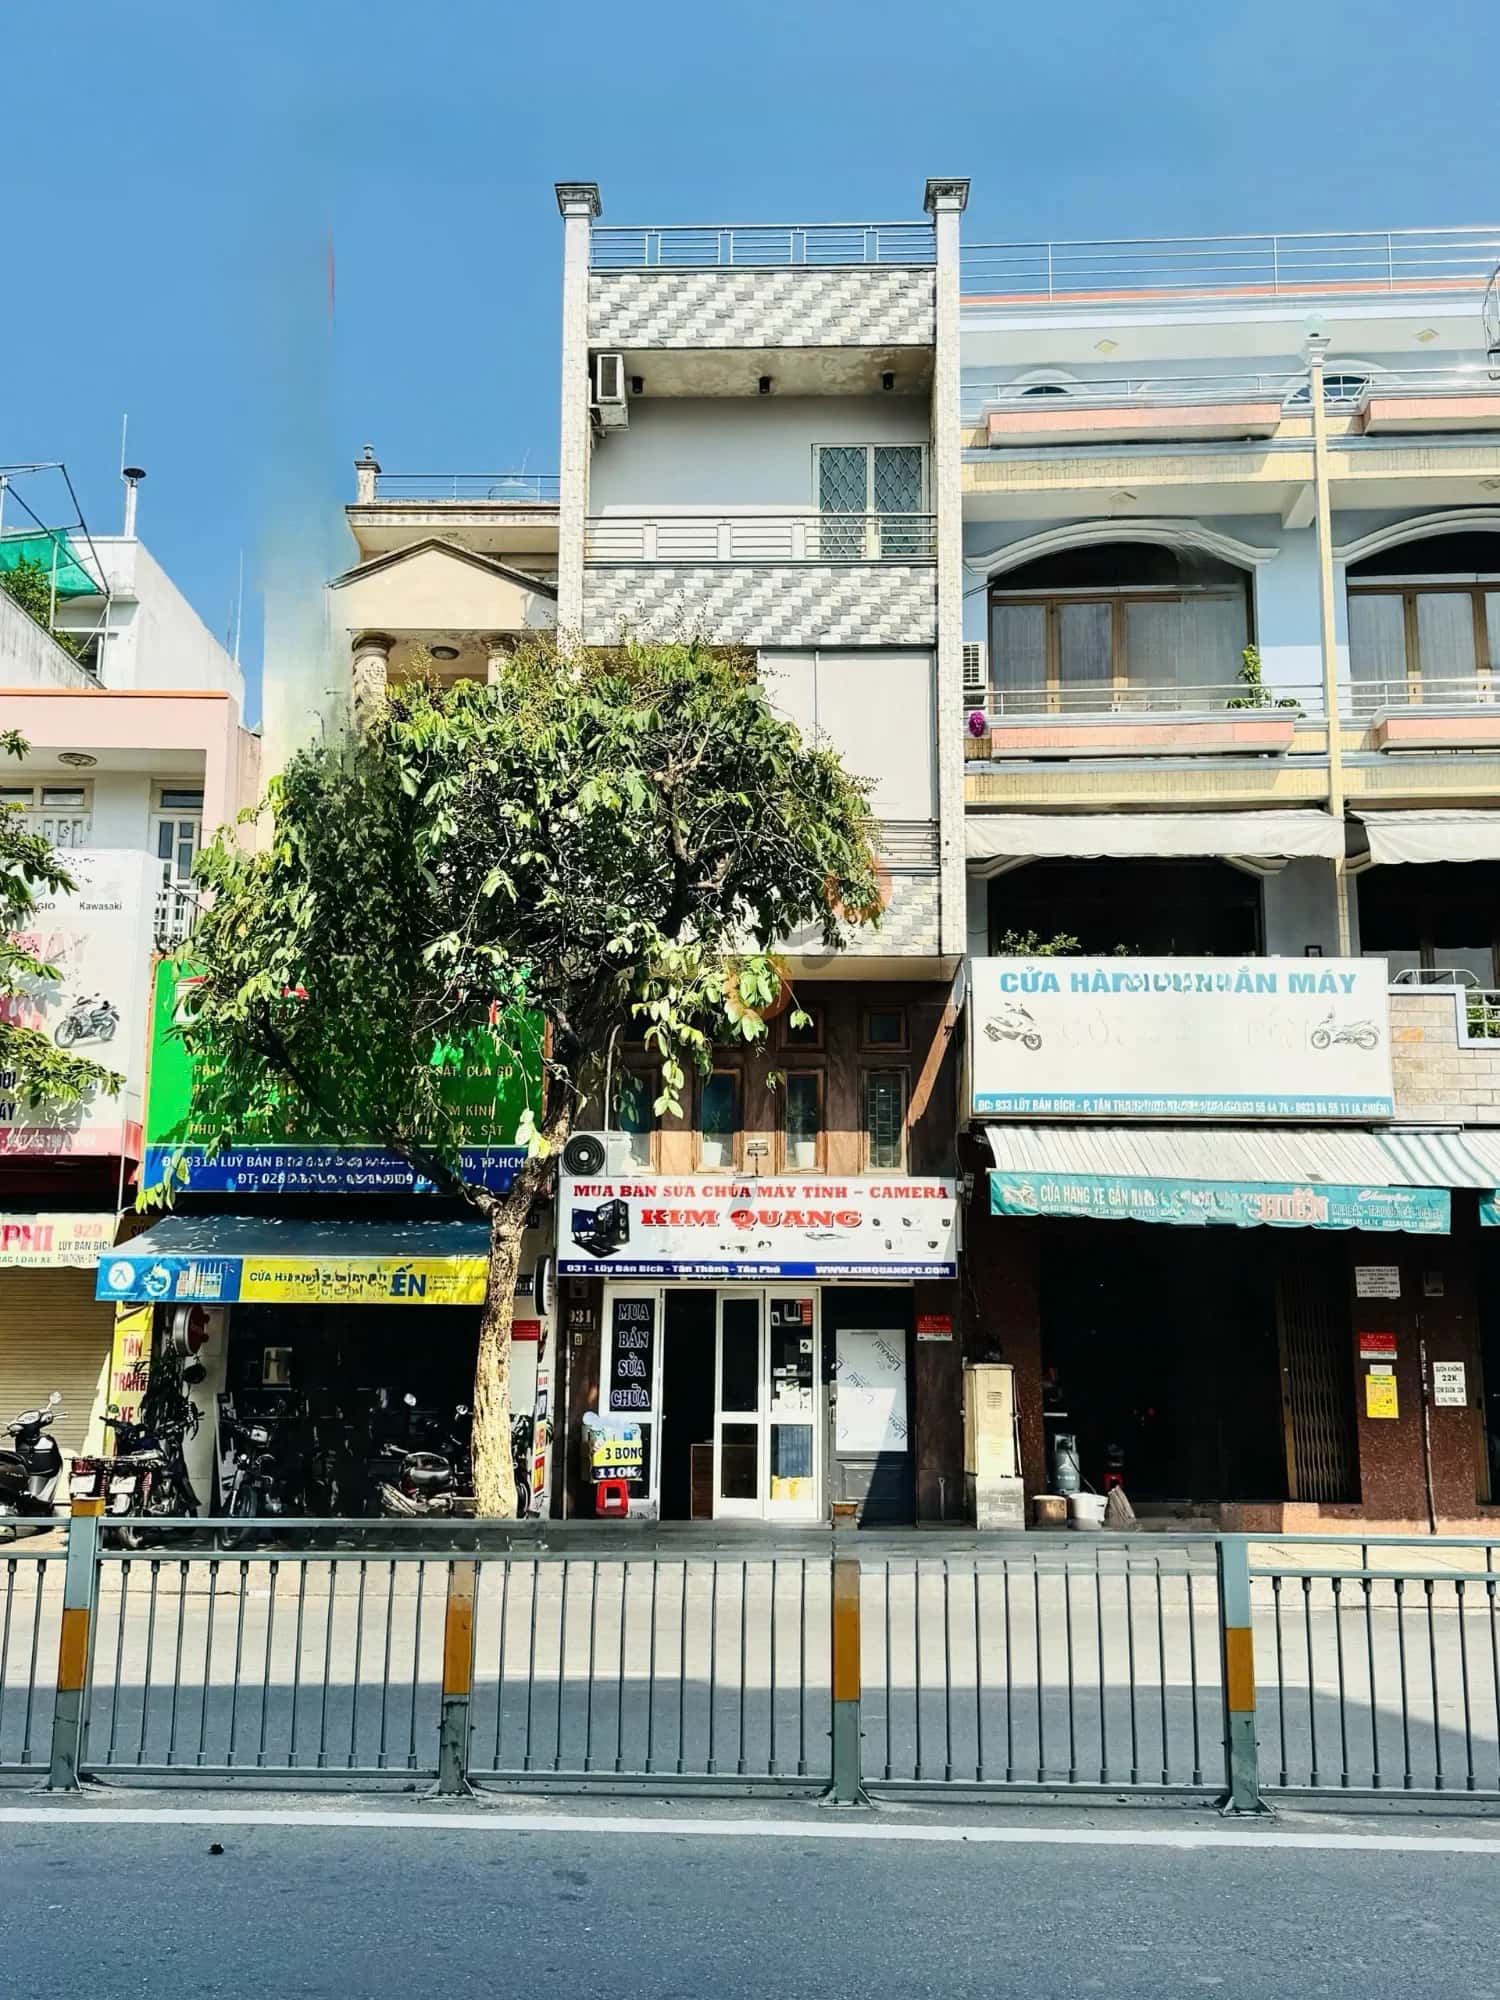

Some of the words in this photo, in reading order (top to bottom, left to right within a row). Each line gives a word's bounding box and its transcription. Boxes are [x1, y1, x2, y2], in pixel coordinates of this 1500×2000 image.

[79, 901, 122, 911] Kawasaki
[999, 966, 1061, 994] CỬA
[1287, 967, 1358, 994] MÁY
[480, 1156, 524, 1168] TP.HCM
[573, 1184, 614, 1198] MUA
[619, 1182, 657, 1198] BÁN
[757, 1183, 796, 1199] MÁY
[802, 1183, 848, 1199] TÍNH
[869, 1185, 949, 1200] CAMERA
[1093, 1187, 1105, 1206] XE
[640, 1208, 720, 1227] KIM
[730, 1208, 863, 1231] QUANG
[618, 1303, 650, 1320] MUA
[605, 1447, 612, 1460] 3
